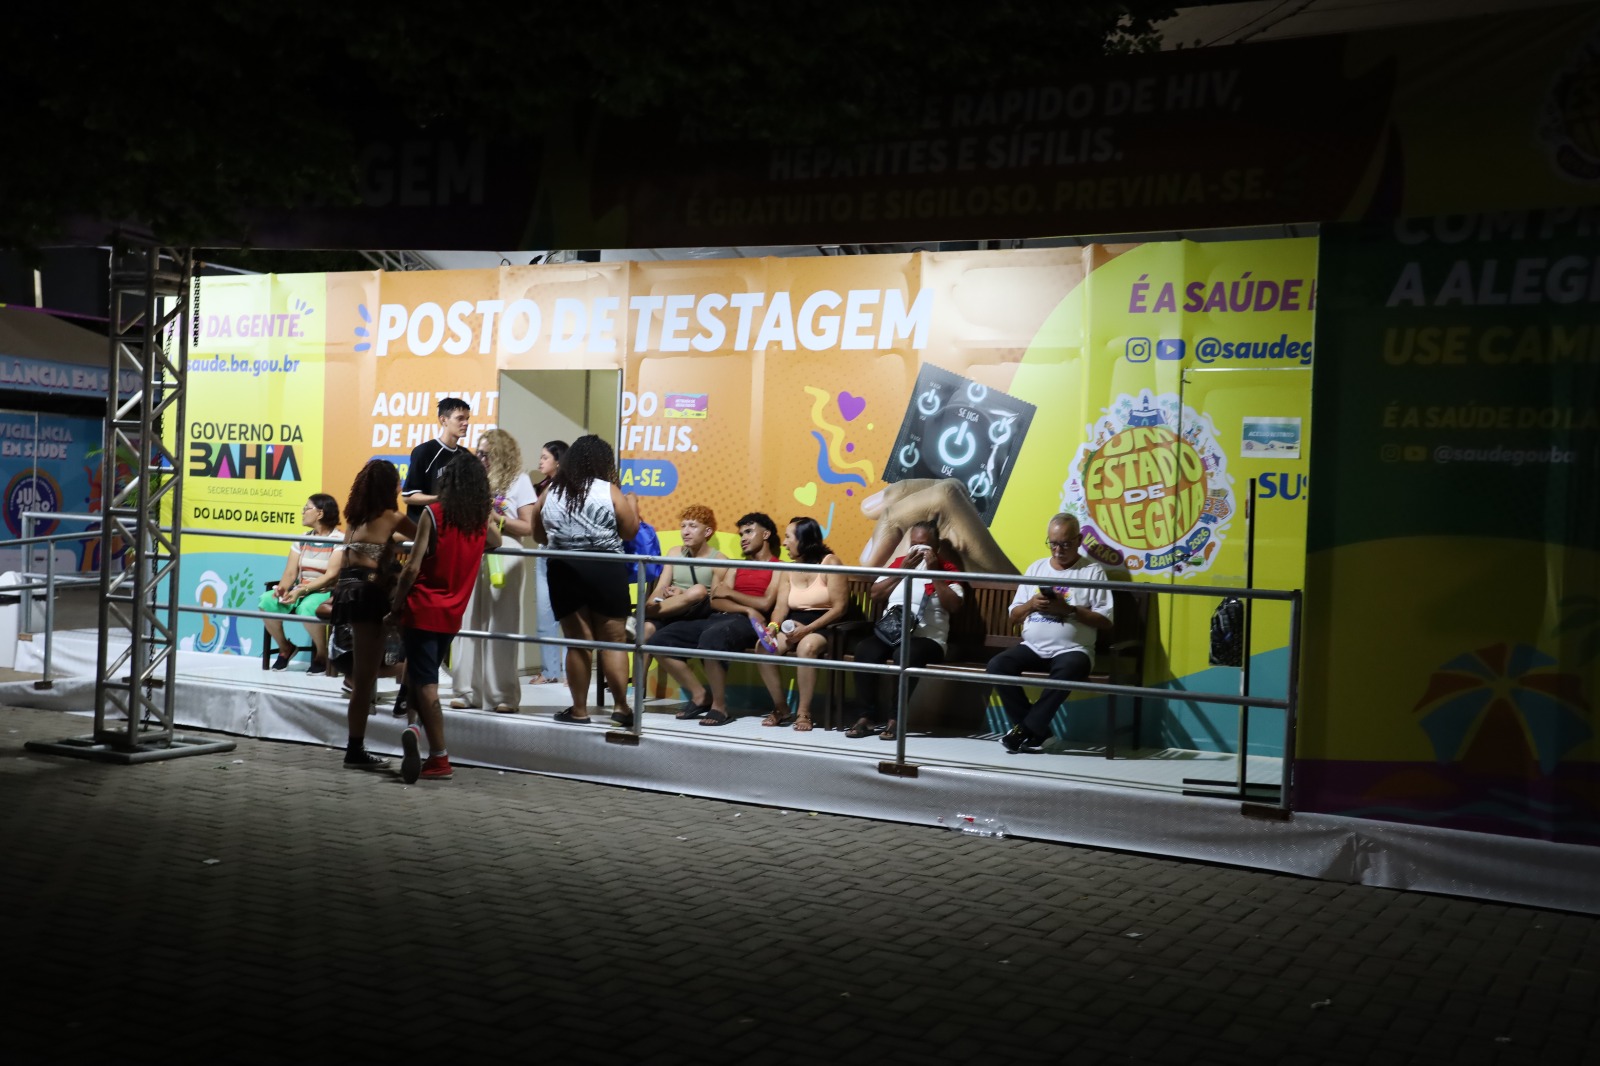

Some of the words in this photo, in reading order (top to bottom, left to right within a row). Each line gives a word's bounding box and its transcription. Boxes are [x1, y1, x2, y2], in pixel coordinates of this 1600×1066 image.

[1103, 78, 1156, 116] DE
[1164, 69, 1243, 113] HIV,
[769, 138, 949, 180] HEPATITES
[956, 138, 977, 171] E
[985, 123, 1124, 169] SÍFILIS.
[706, 193, 853, 226] GRATUITO
[859, 191, 877, 222] E
[883, 181, 1044, 221] SIGILOSO.
[1054, 168, 1273, 212] PREVINA-SE.
[1128, 273, 1150, 313] É
[1152, 282, 1177, 313] A
[1183, 271, 1303, 313] SAÚDE
[1385, 261, 1426, 307] A
[206, 314, 232, 338] DA
[236, 313, 305, 338] GENTE.
[375, 297, 541, 357] POSTO
[549, 296, 621, 354] DE
[629, 288, 936, 352] TESTAGEM
[1382, 325, 1472, 366] USE
[73, 369, 98, 391] EM
[372, 391, 430, 417] AQUI
[1402, 406, 1420, 428] A
[1424, 399, 1513, 429] SAÚDE
[1517, 406, 1561, 429] DO
[191, 422, 274, 442] GOVERNO
[280, 424, 303, 442] DA
[372, 423, 403, 448] DE
[1104, 427, 1175, 457] UM
[2, 441, 21, 457] EM
[189, 442, 302, 481] BAHIA
[1087, 441, 1203, 500] ESTADO
[207, 486, 248, 496] SECRETARIA
[250, 488, 259, 497] DA
[260, 487, 283, 497] SAÚDE
[1123, 483, 1166, 503] DE
[194, 507, 210, 519] DO
[213, 508, 242, 521] LADO
[245, 510, 259, 522] DA
[261, 511, 295, 524] GENTE
[1095, 482, 1205, 549] ALEGRIA
[1083, 532, 1119, 563] VERÃO
[1189, 528, 1210, 550] 2026
